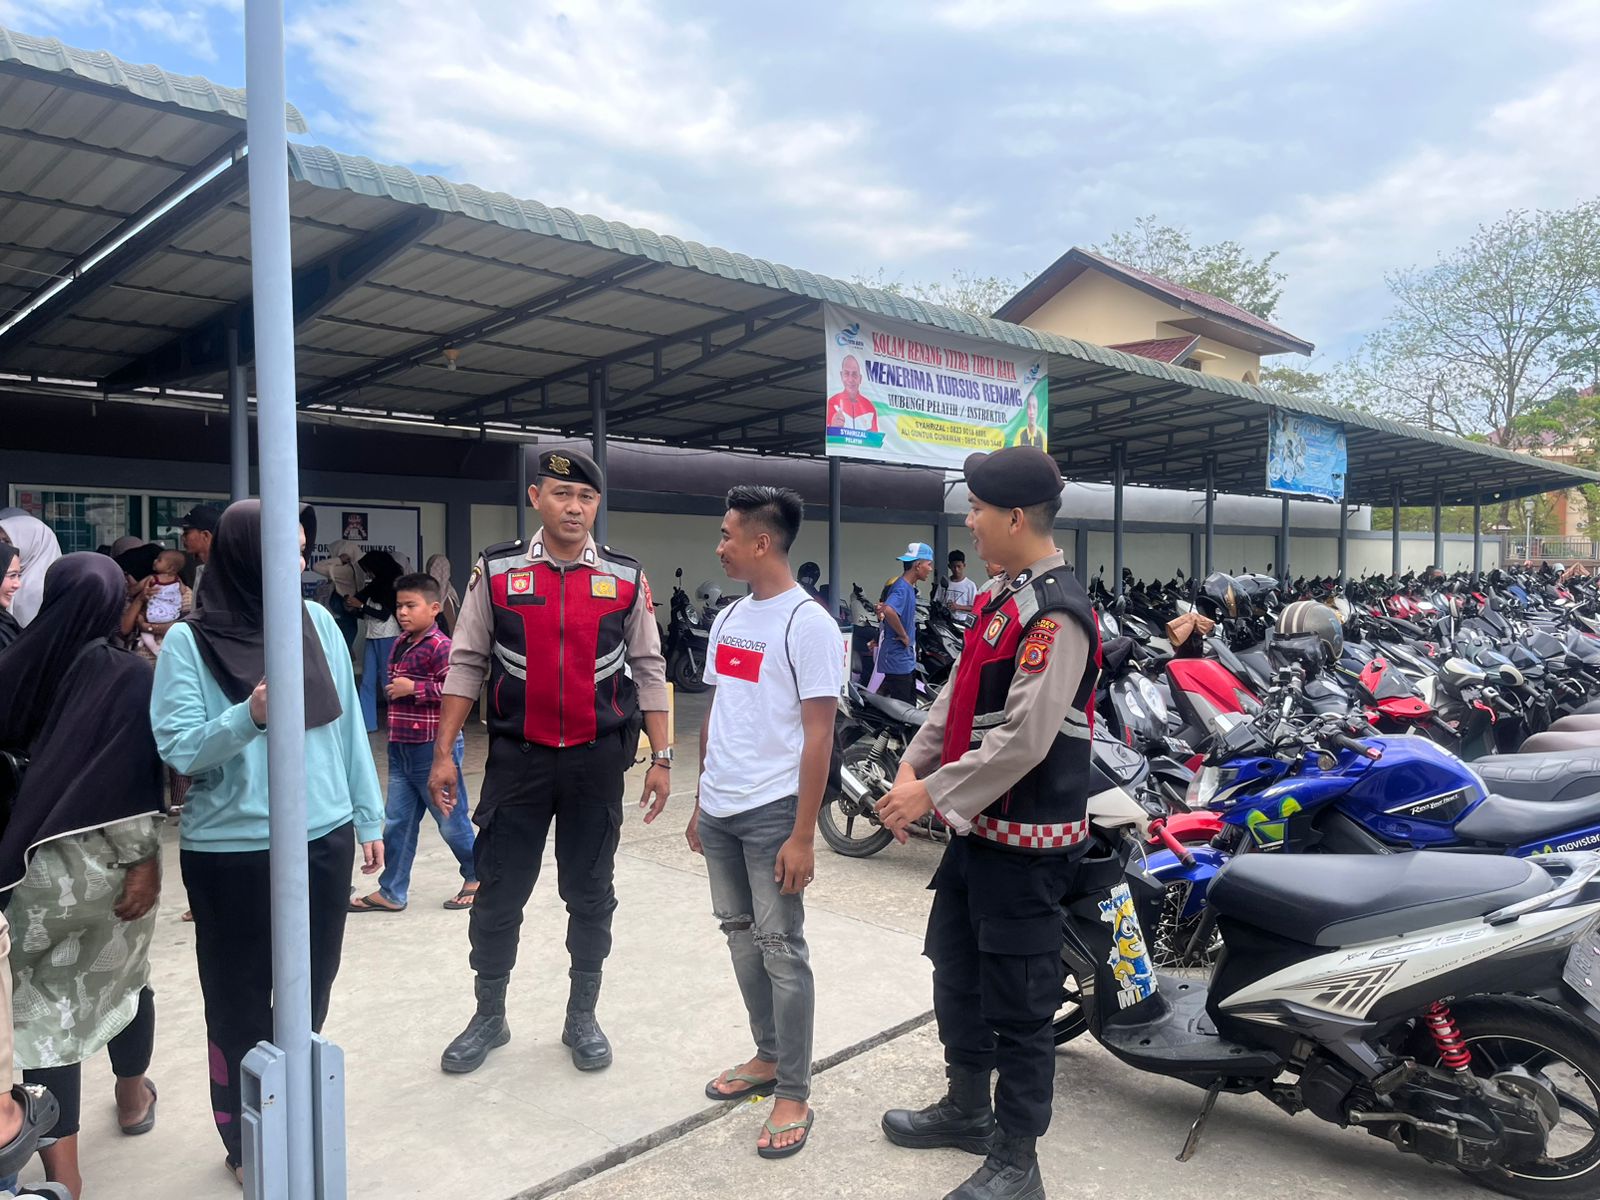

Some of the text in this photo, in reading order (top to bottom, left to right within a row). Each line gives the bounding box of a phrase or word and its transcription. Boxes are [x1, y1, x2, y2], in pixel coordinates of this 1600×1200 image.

[872, 331, 905, 360] KOLAM
[907, 340, 943, 366] RENANG
[971, 353, 995, 378] TIRTA
[996, 359, 1017, 381] RAYA
[865, 360, 1023, 408] MENERIMA KURSUS RENANG
[888, 394, 925, 411] HUBUNGI
[927, 400, 958, 417] PELATIH
[1557, 834, 1600, 852] movistar
[1413, 934, 1523, 978] LIQUID COOLED
